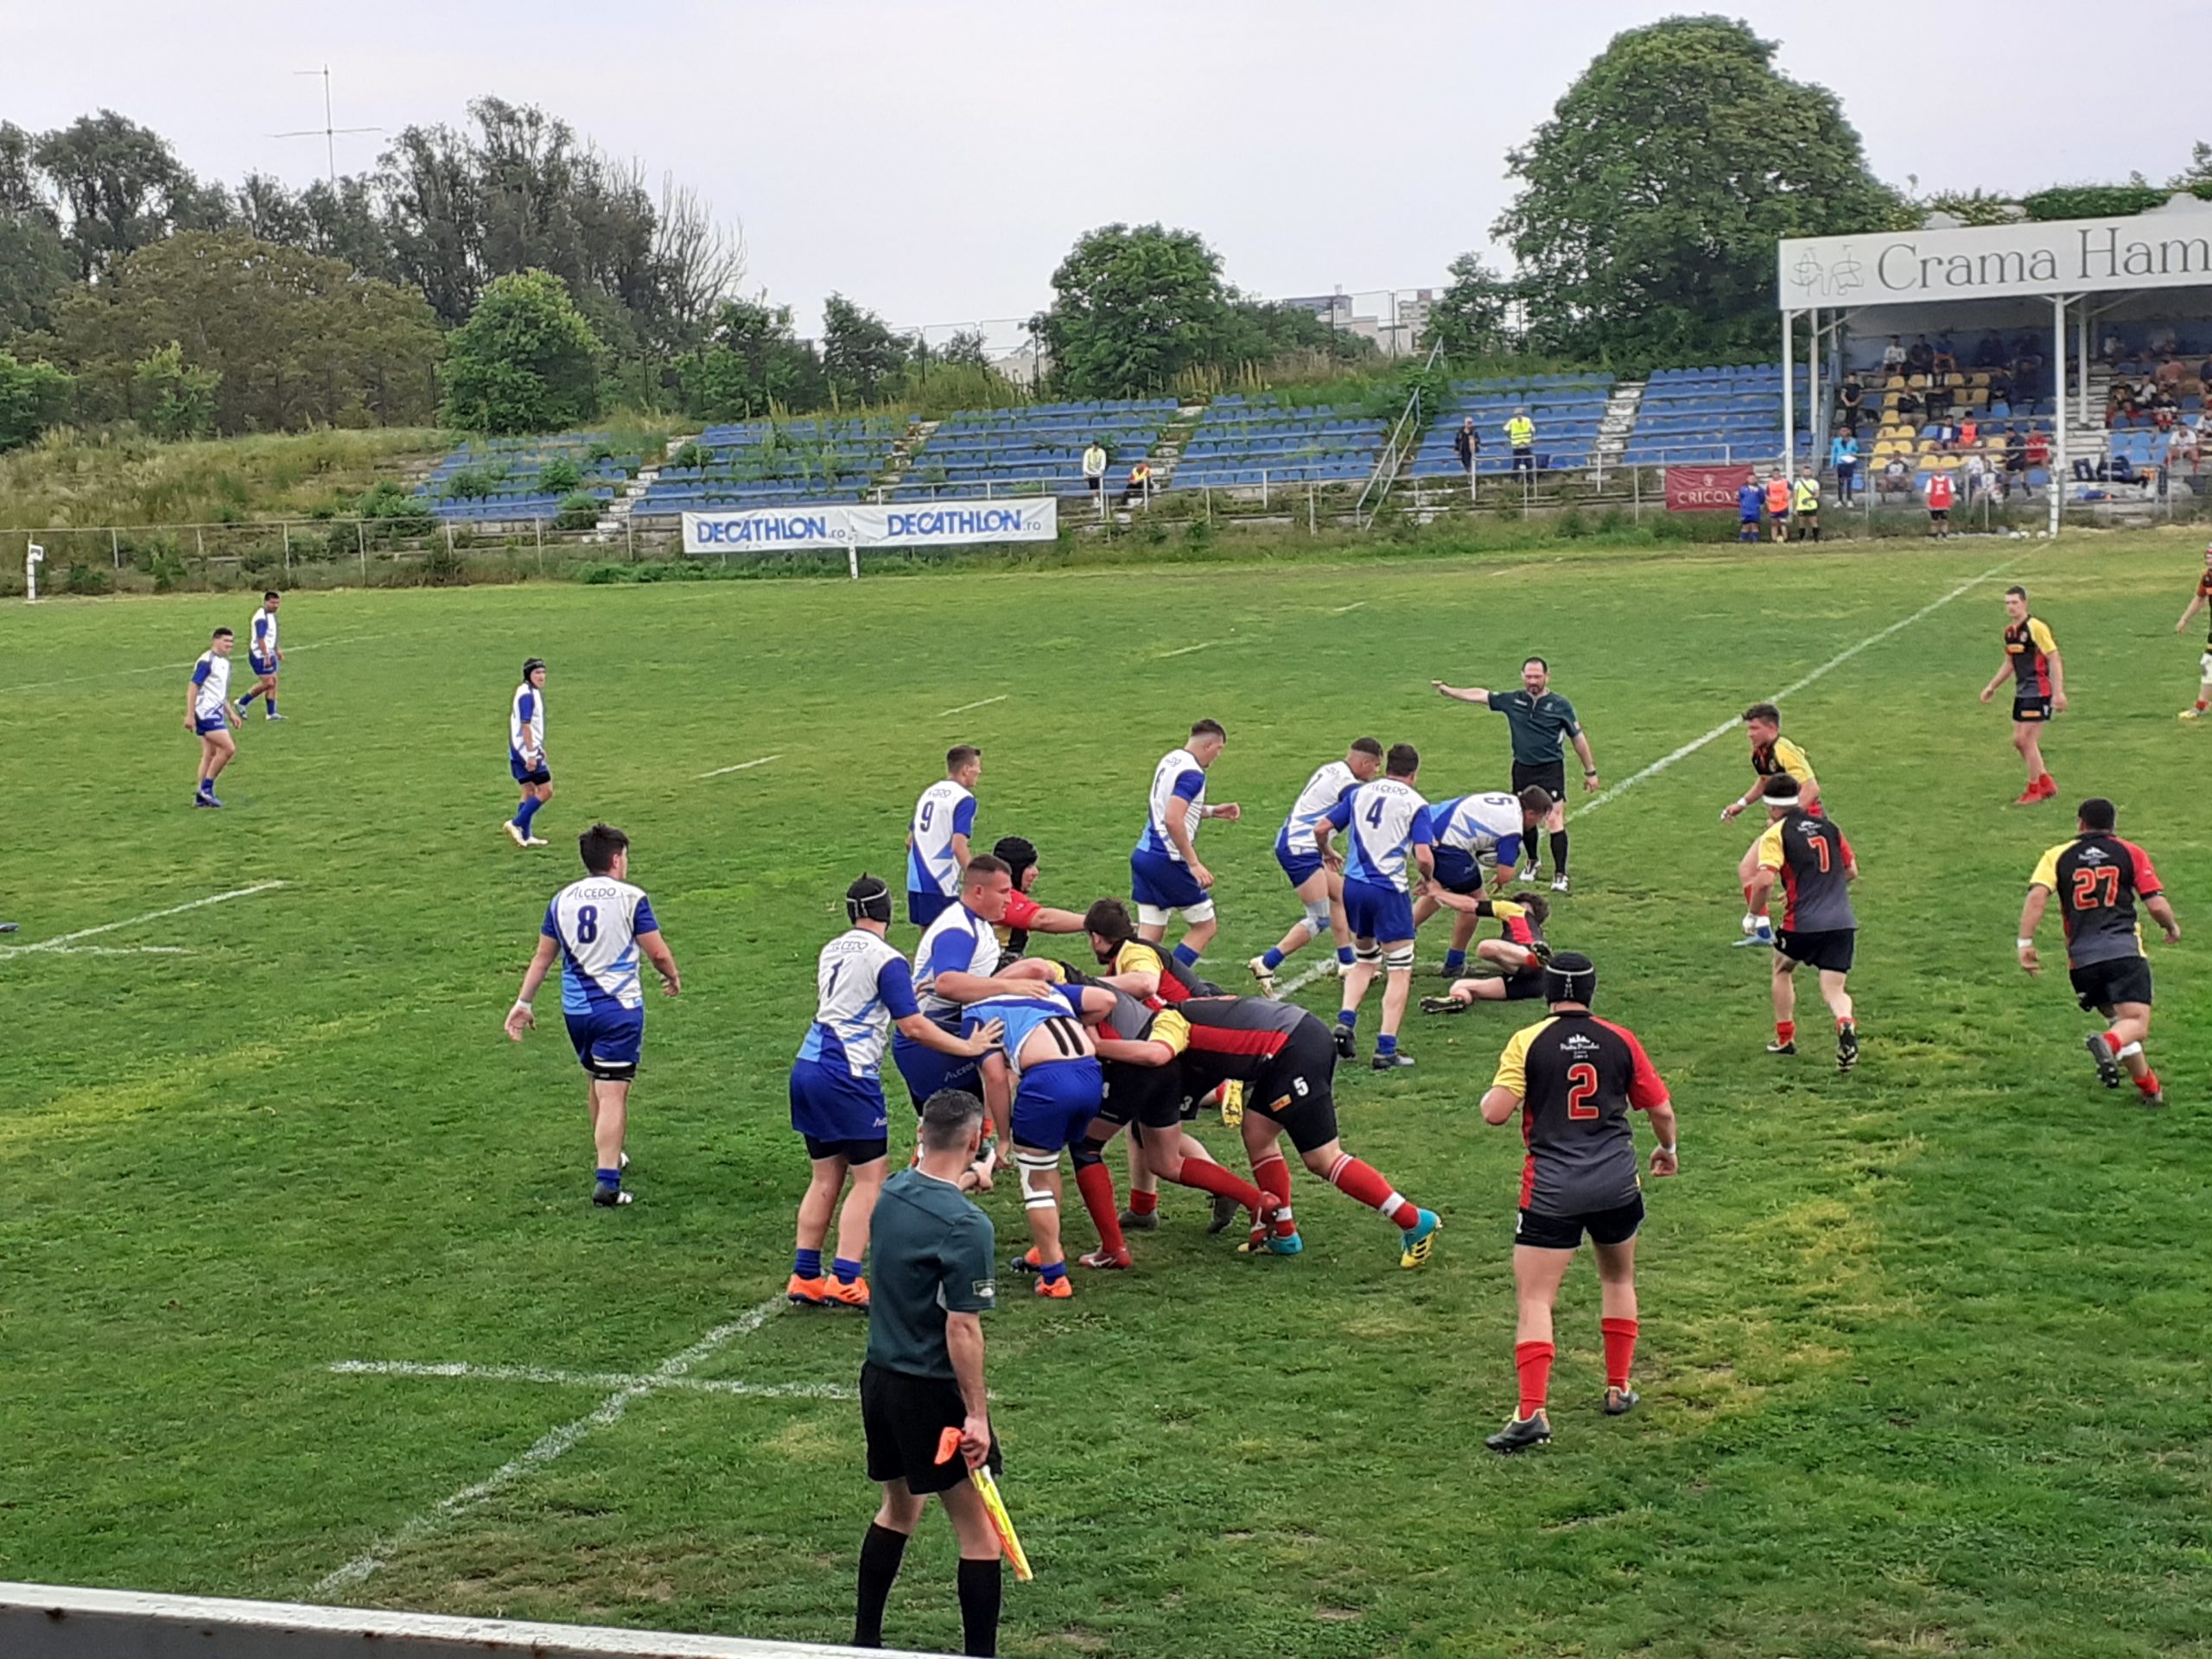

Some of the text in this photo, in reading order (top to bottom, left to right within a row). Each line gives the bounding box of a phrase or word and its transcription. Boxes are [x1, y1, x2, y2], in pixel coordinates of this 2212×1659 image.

[1878, 226, 2212, 290] Crama Ham
[919, 800, 935, 833] 9
[1365, 796, 1388, 830] 4
[1807, 835, 1830, 874] 7
[566, 886, 617, 899] ALCEDO
[2072, 865, 2120, 911] 27
[577, 904, 599, 944] 8
[1179, 1095, 1193, 1111] 3
[1293, 1076, 1309, 1096] 5
[1567, 1062, 1599, 1121] 2
